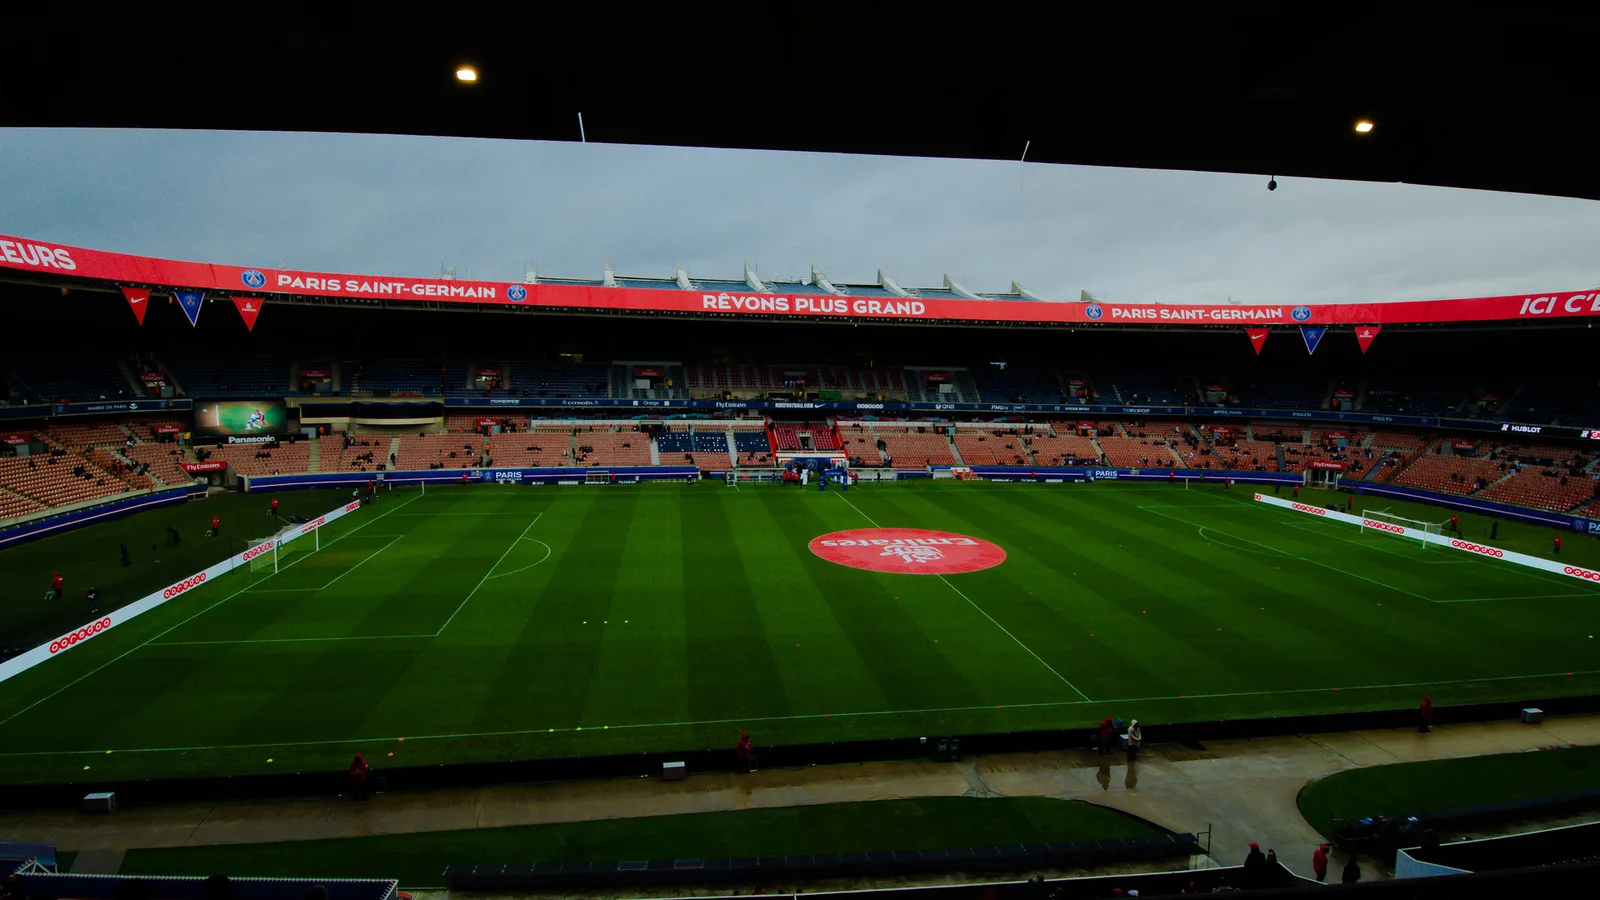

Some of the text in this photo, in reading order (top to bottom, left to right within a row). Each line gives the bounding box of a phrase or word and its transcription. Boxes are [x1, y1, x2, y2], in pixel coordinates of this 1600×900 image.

[0, 240, 76, 270] EURS
[277, 274, 496, 298] PARIS SAINT-GERMAIN
[703, 293, 925, 315] RÊVONS PLUS GRAND
[1519, 296, 1558, 315] ICI
[1111, 307, 1283, 320] PARIS SAINT-GERMAIN
[1511, 425, 1541, 433] HUBLOT
[228, 435, 275, 444] Panasonic
[1363, 519, 1404, 534] ooredoo
[820, 537, 979, 547] Emirates
[1451, 540, 1504, 558] ooredoo
[164, 573, 206, 599] ooredoo
[49, 617, 111, 654] ooredoo
